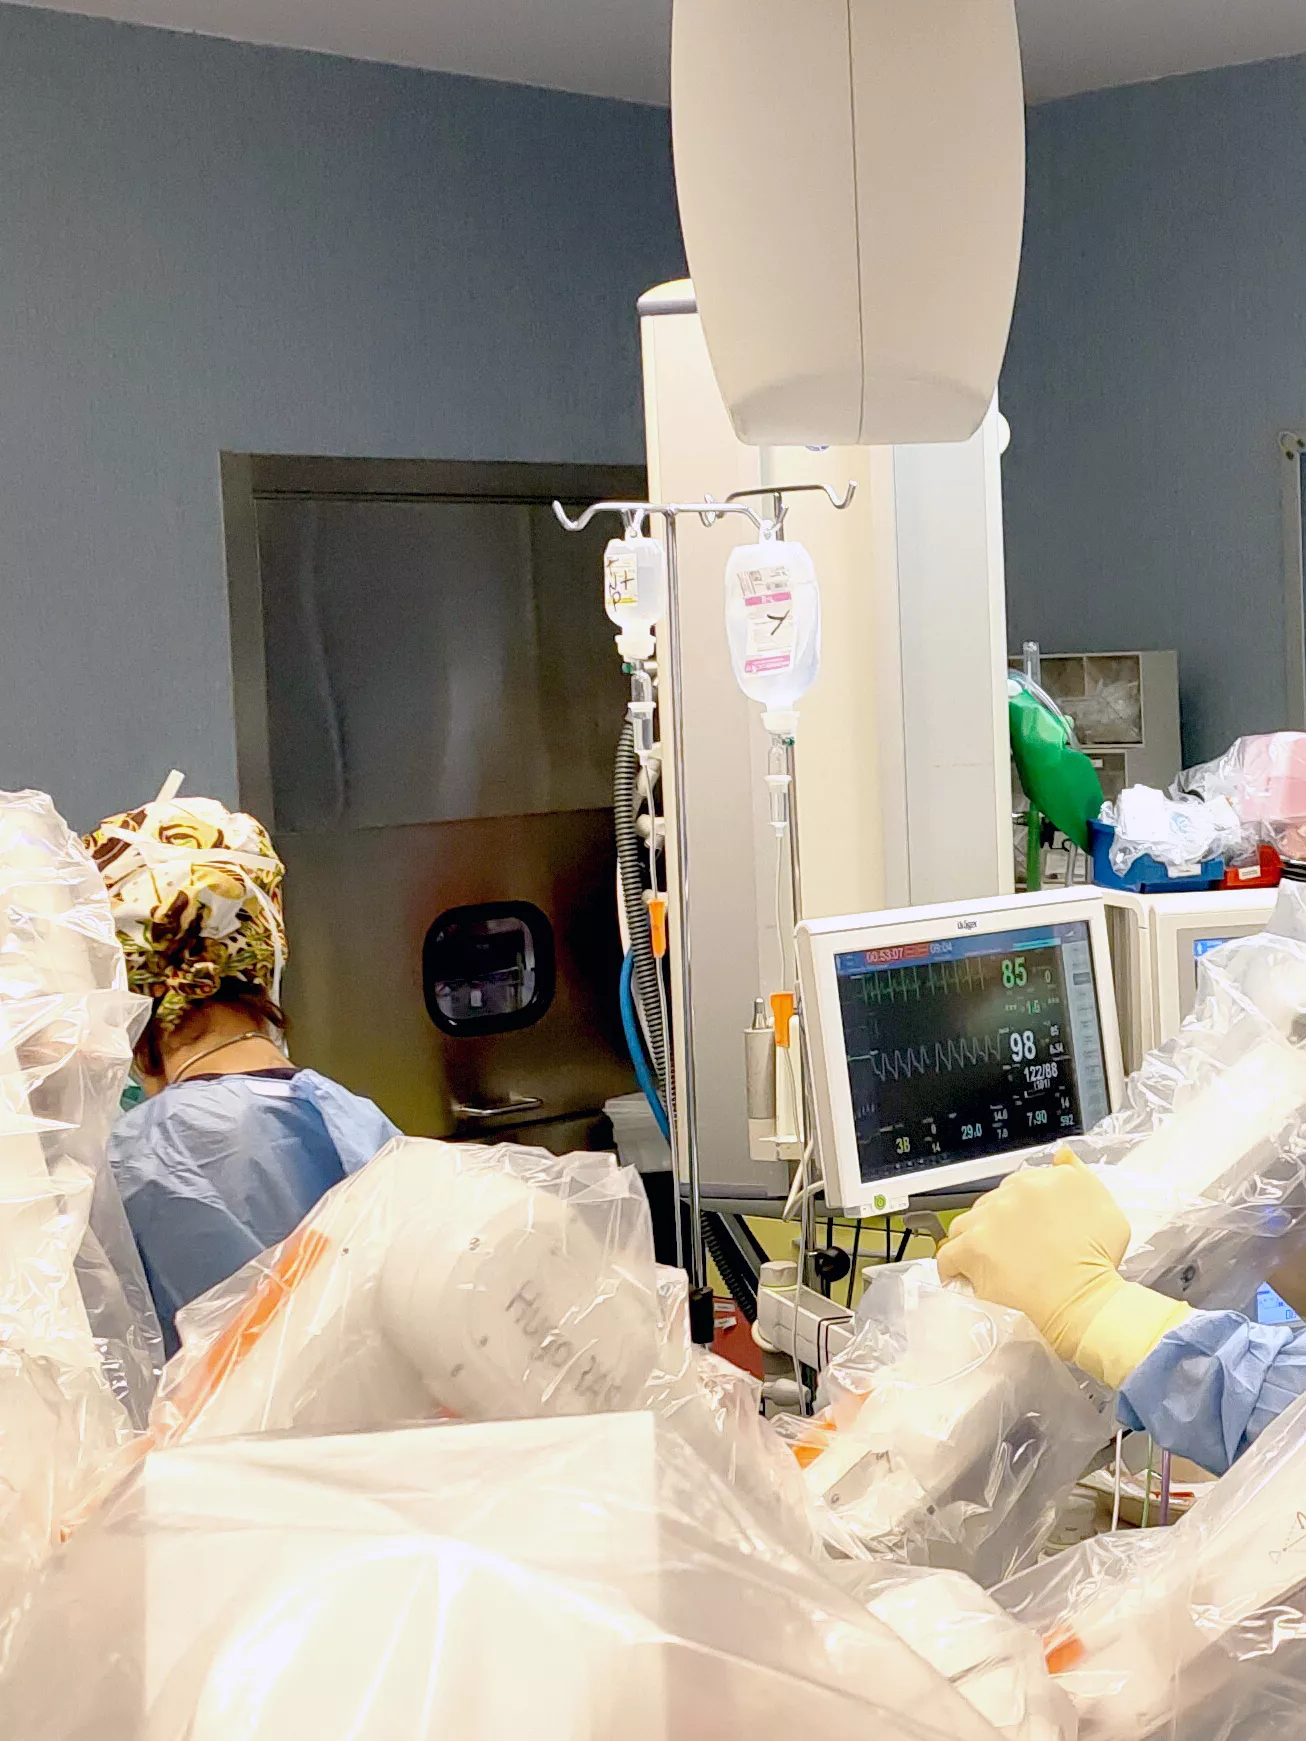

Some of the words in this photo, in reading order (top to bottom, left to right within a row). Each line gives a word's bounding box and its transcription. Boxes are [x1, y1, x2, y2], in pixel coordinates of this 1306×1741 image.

[1001, 956, 1029, 989] 85
[1009, 1030, 1037, 1063] 98
[1023, 1061, 1059, 1083] 122/88
